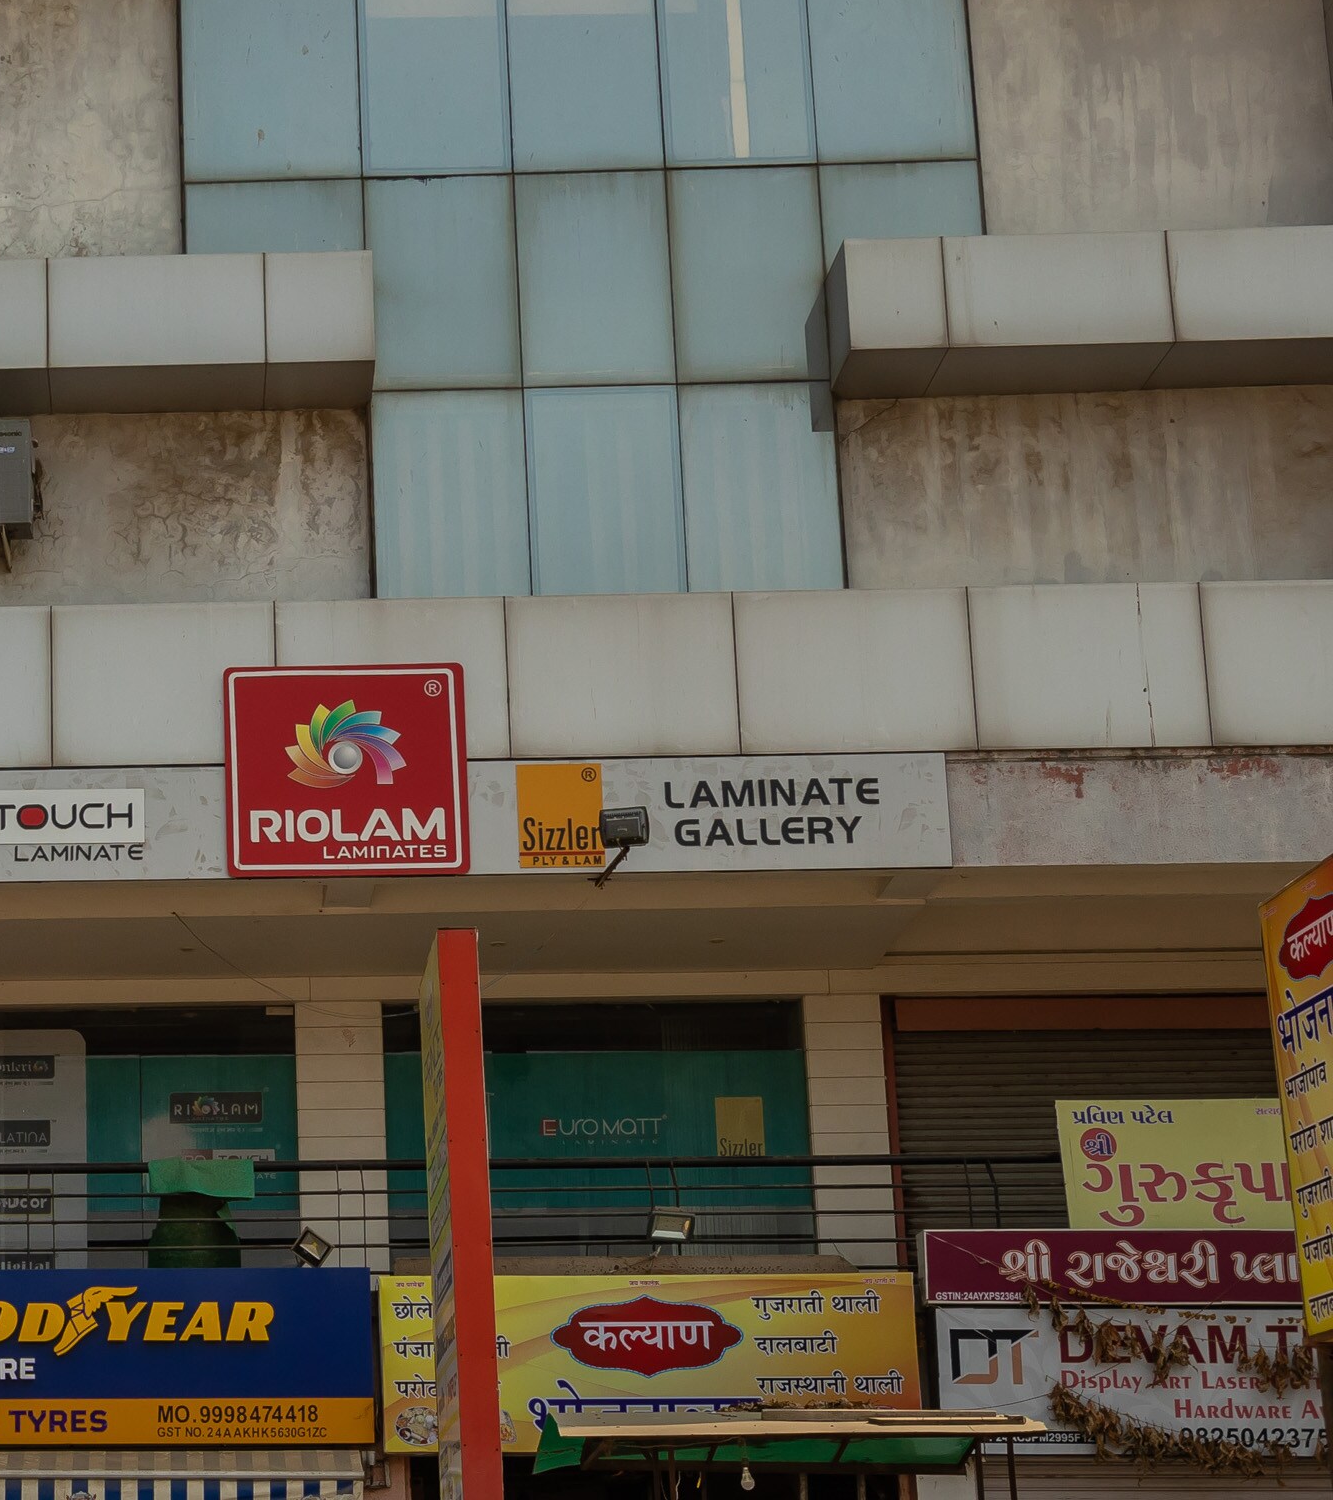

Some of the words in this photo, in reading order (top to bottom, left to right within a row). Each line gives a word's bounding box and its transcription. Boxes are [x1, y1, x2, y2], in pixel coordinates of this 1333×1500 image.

[664, 778, 880, 809] LAMINATE
[250, 808, 447, 844] RIOLAM
[523, 816, 603, 852] Sizzler
[674, 815, 863, 848] GALLERY
[14, 845, 144, 863] LAMINATE
[323, 845, 448, 860] LAMINATES
[533, 856, 558, 866] PLY
[574, 855, 604, 866] LAM
[1130, 1105, 1174, 1125] પટેલ
[719, 1137, 764, 1157] Sizzler
[998, 1238, 1053, 1284] શ્રી
[751, 1290, 824, 1320] गुजराती
[831, 1289, 880, 1314] थाली
[579, 1320, 714, 1352] कल्याण
[754, 1330, 837, 1356] दालबाटी
[756, 1370, 846, 1395] राजस्थानी
[854, 1369, 903, 1395] थाली
[9, 1410, 109, 1434] TYRES
[157, 1426, 182, 1439] GST
[185, 1426, 206, 1439] NO.
